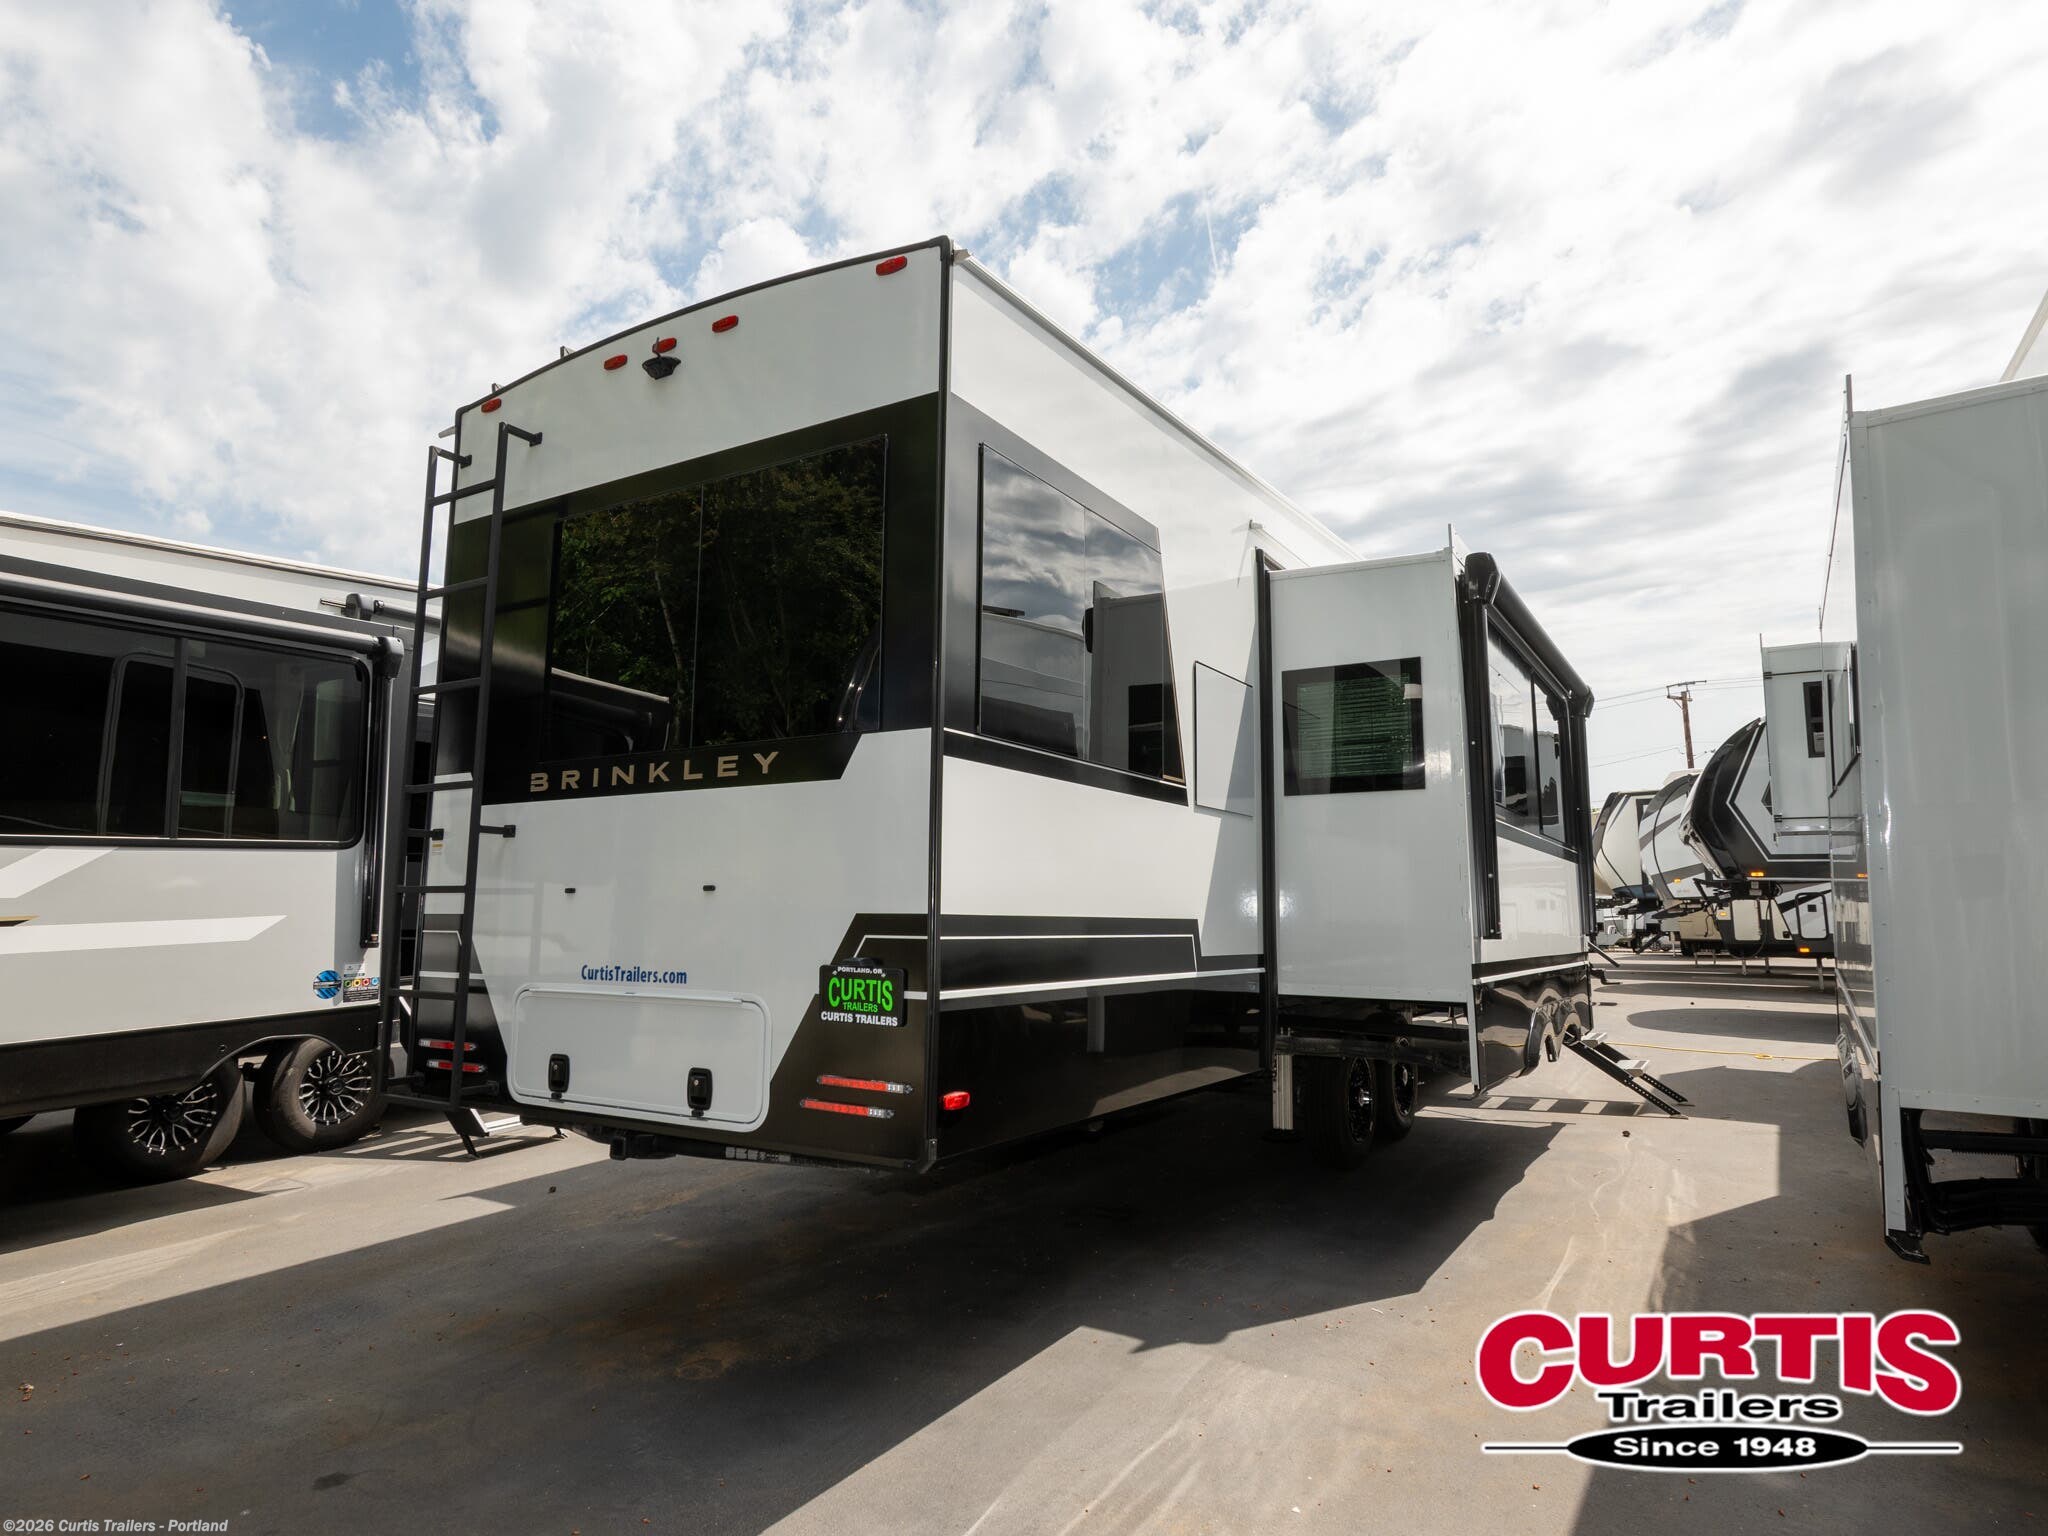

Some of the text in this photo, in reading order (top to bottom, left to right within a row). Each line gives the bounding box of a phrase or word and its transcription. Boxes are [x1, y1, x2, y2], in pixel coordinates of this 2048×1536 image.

[530, 751, 779, 792] BRINKLEY
[581, 964, 687, 984] CurtisTrailers.com
[828, 977, 893, 1012] CURTIS
[843, 1002, 879, 1013] TRAILERS
[821, 1011, 898, 1027] CURTIS TRAILERS
